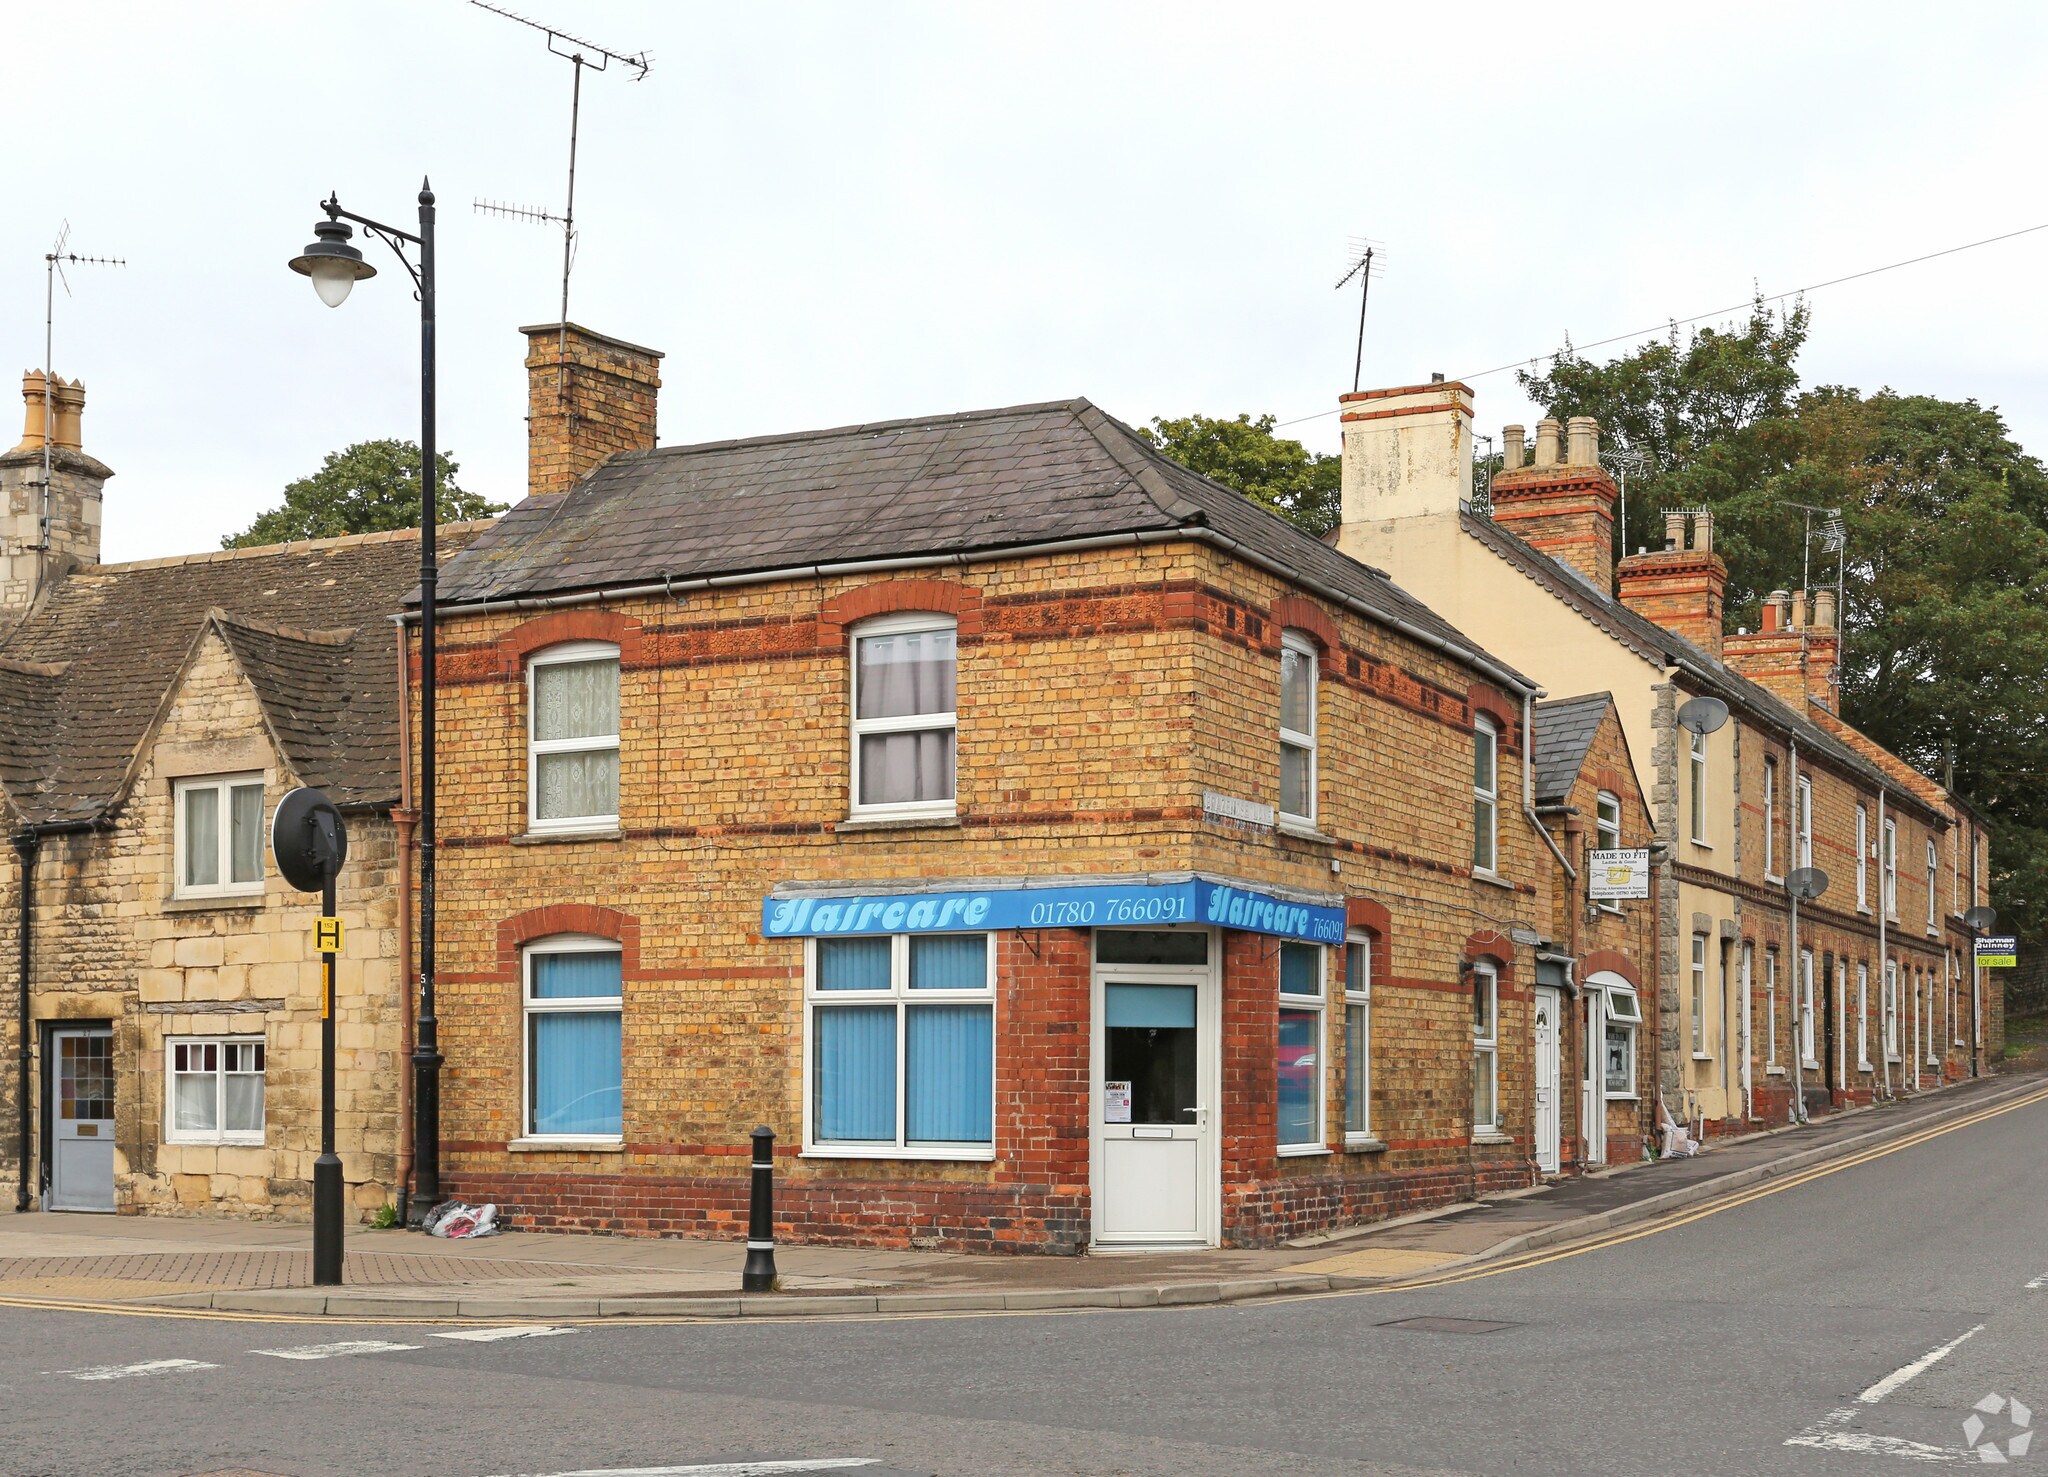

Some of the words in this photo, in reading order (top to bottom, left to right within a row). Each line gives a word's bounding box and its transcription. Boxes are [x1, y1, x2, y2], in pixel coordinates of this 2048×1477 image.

[770, 896, 991, 933] Haircare
[1031, 900, 1095, 924] 01780
[1106, 897, 1186, 921] 766091
[1208, 885, 1309, 935] Haircare
[1313, 917, 1343, 941] 766091
[317, 920, 340, 948] H
[1978, 957, 1991, 965] for
[1993, 957, 2011, 965] sale
